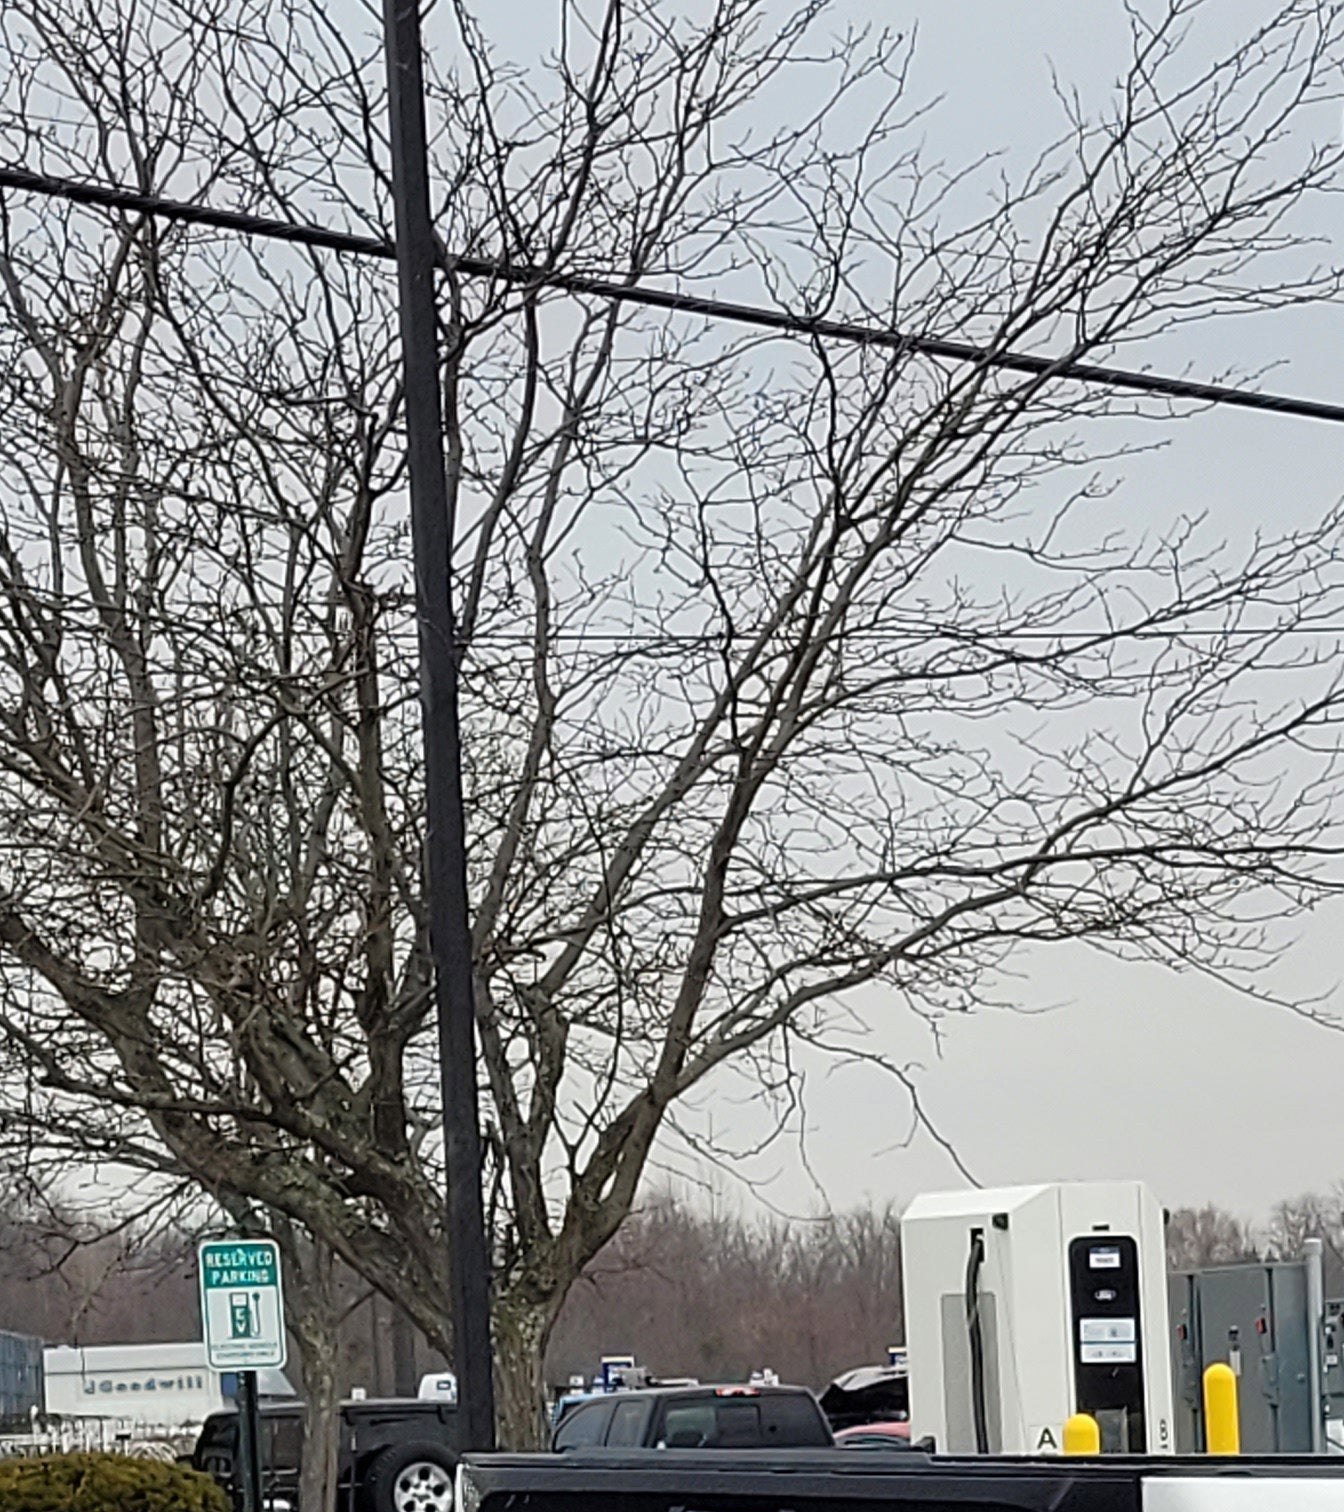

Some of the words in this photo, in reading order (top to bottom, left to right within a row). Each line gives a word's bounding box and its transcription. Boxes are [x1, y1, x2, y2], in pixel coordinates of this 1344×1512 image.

[205, 1250, 273, 1267] RESERVED
[211, 1268, 269, 1285] PARKING
[235, 1307, 247, 1334] EV
[1037, 1426, 1058, 1450] A
